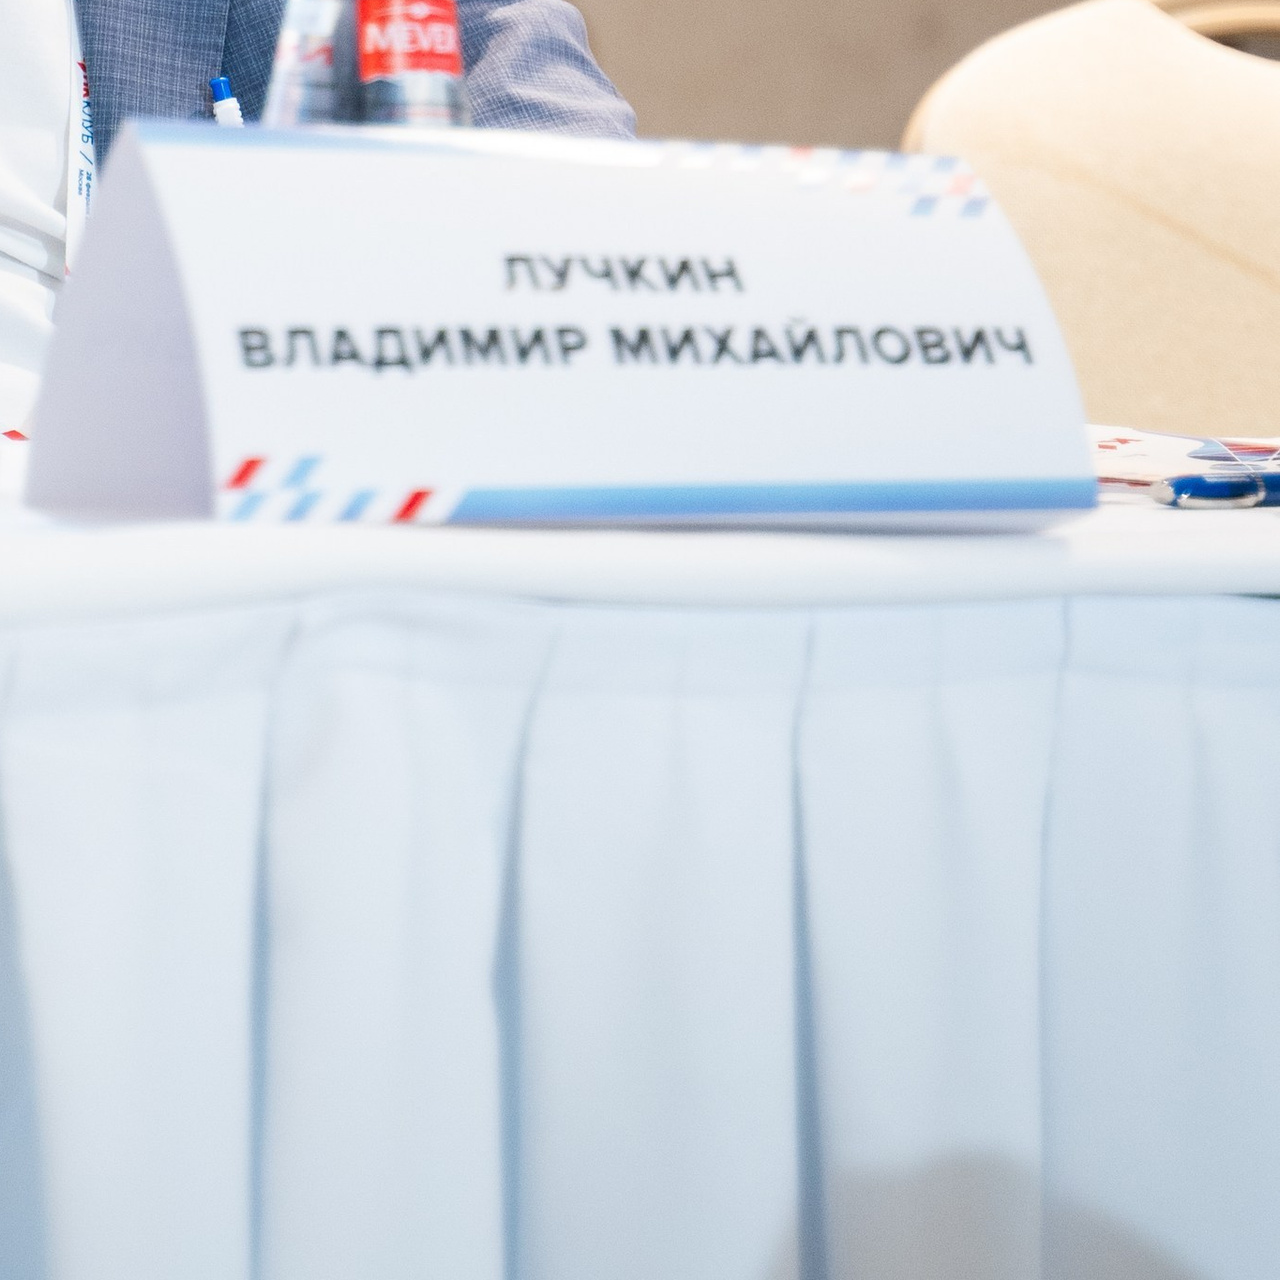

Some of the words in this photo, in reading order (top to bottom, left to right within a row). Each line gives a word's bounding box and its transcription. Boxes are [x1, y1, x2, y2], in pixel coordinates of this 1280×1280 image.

[503, 252, 745, 294] ЛУЧКИН
[236, 325, 589, 377] ВЛАДИМИР
[608, 315, 1035, 366] МИХАЙЛОВИЧ
